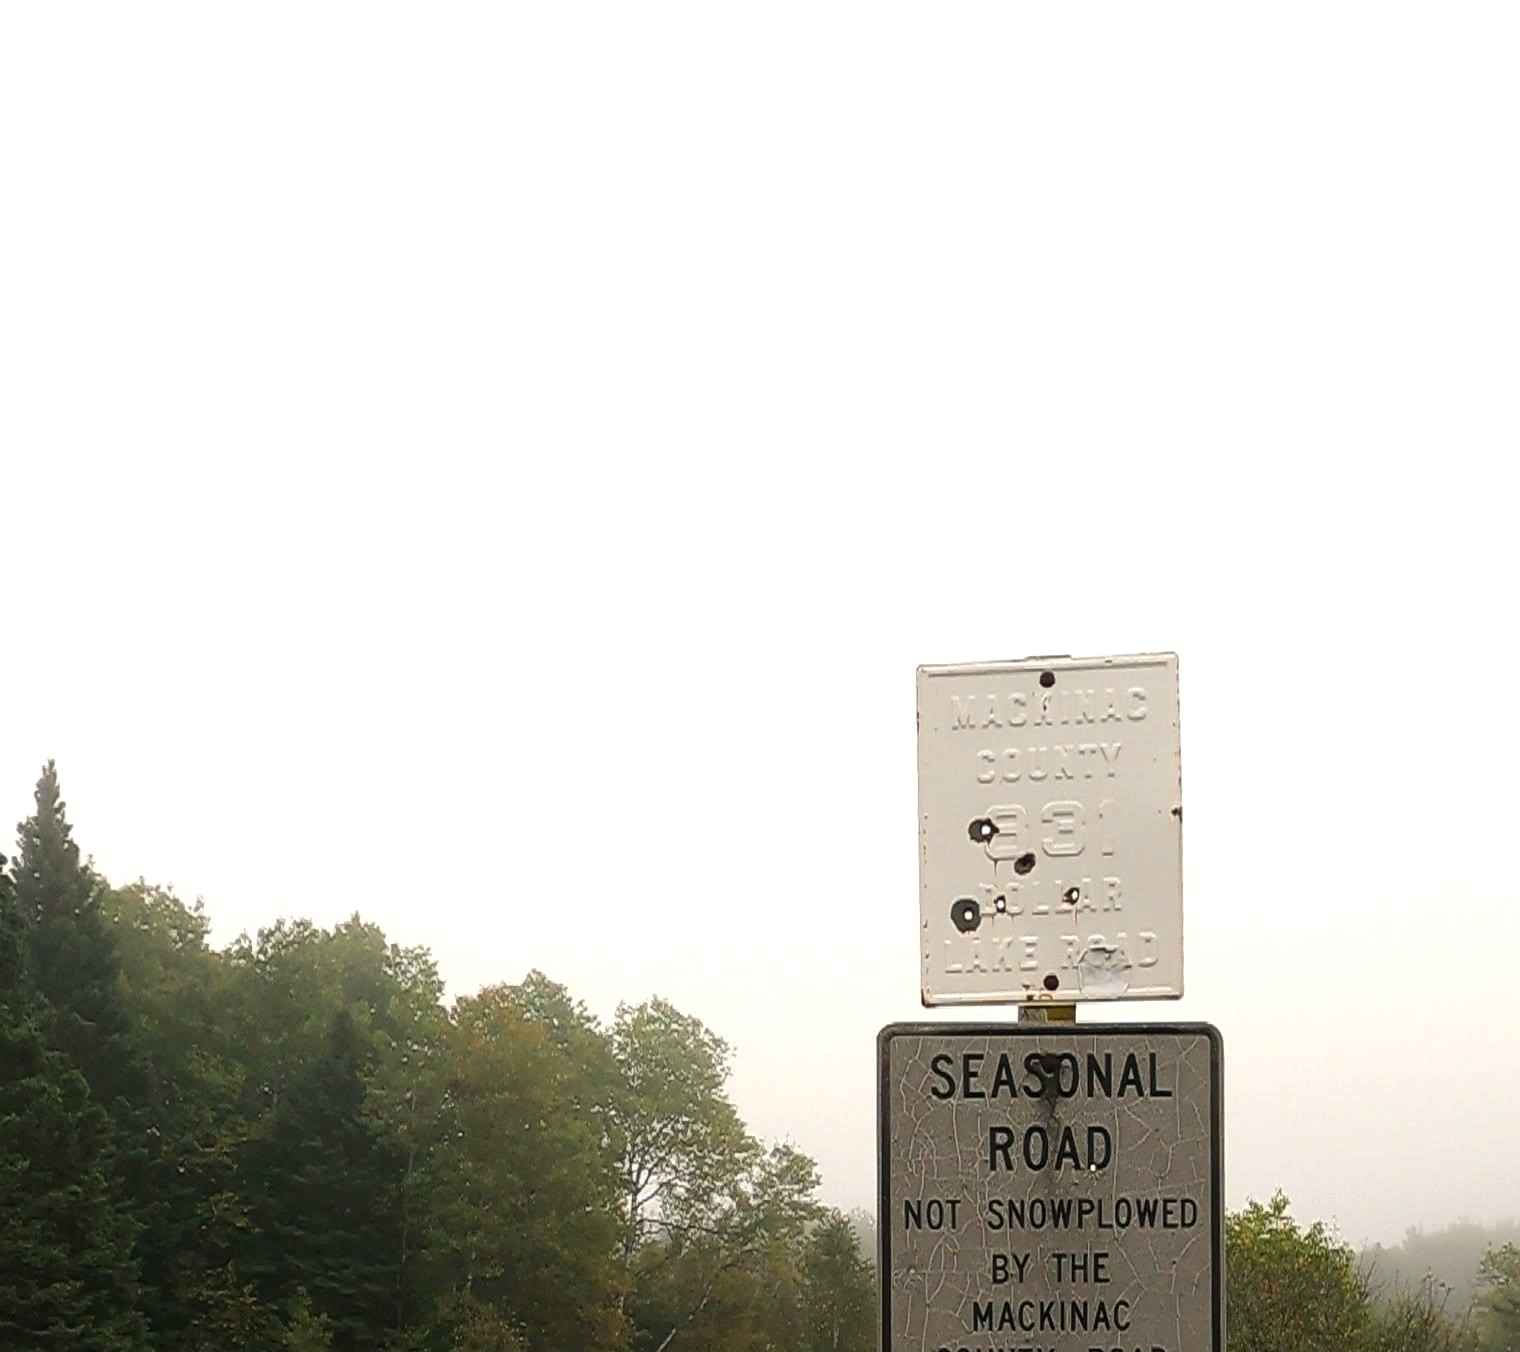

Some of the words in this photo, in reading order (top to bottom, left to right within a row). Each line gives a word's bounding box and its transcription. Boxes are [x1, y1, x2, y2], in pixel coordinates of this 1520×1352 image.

[976, 742, 1122, 784] COUNTY
[930, 1052, 1173, 1100] SEASONAL
[988, 1126, 1113, 1172] ROAD
[904, 1200, 961, 1230] NOT
[988, 1199, 1198, 1231] SNOWPLOWED
[991, 1253, 1030, 1285] BY
[1052, 1252, 1110, 1284] THE
[972, 1300, 1131, 1332] MACKINAC
